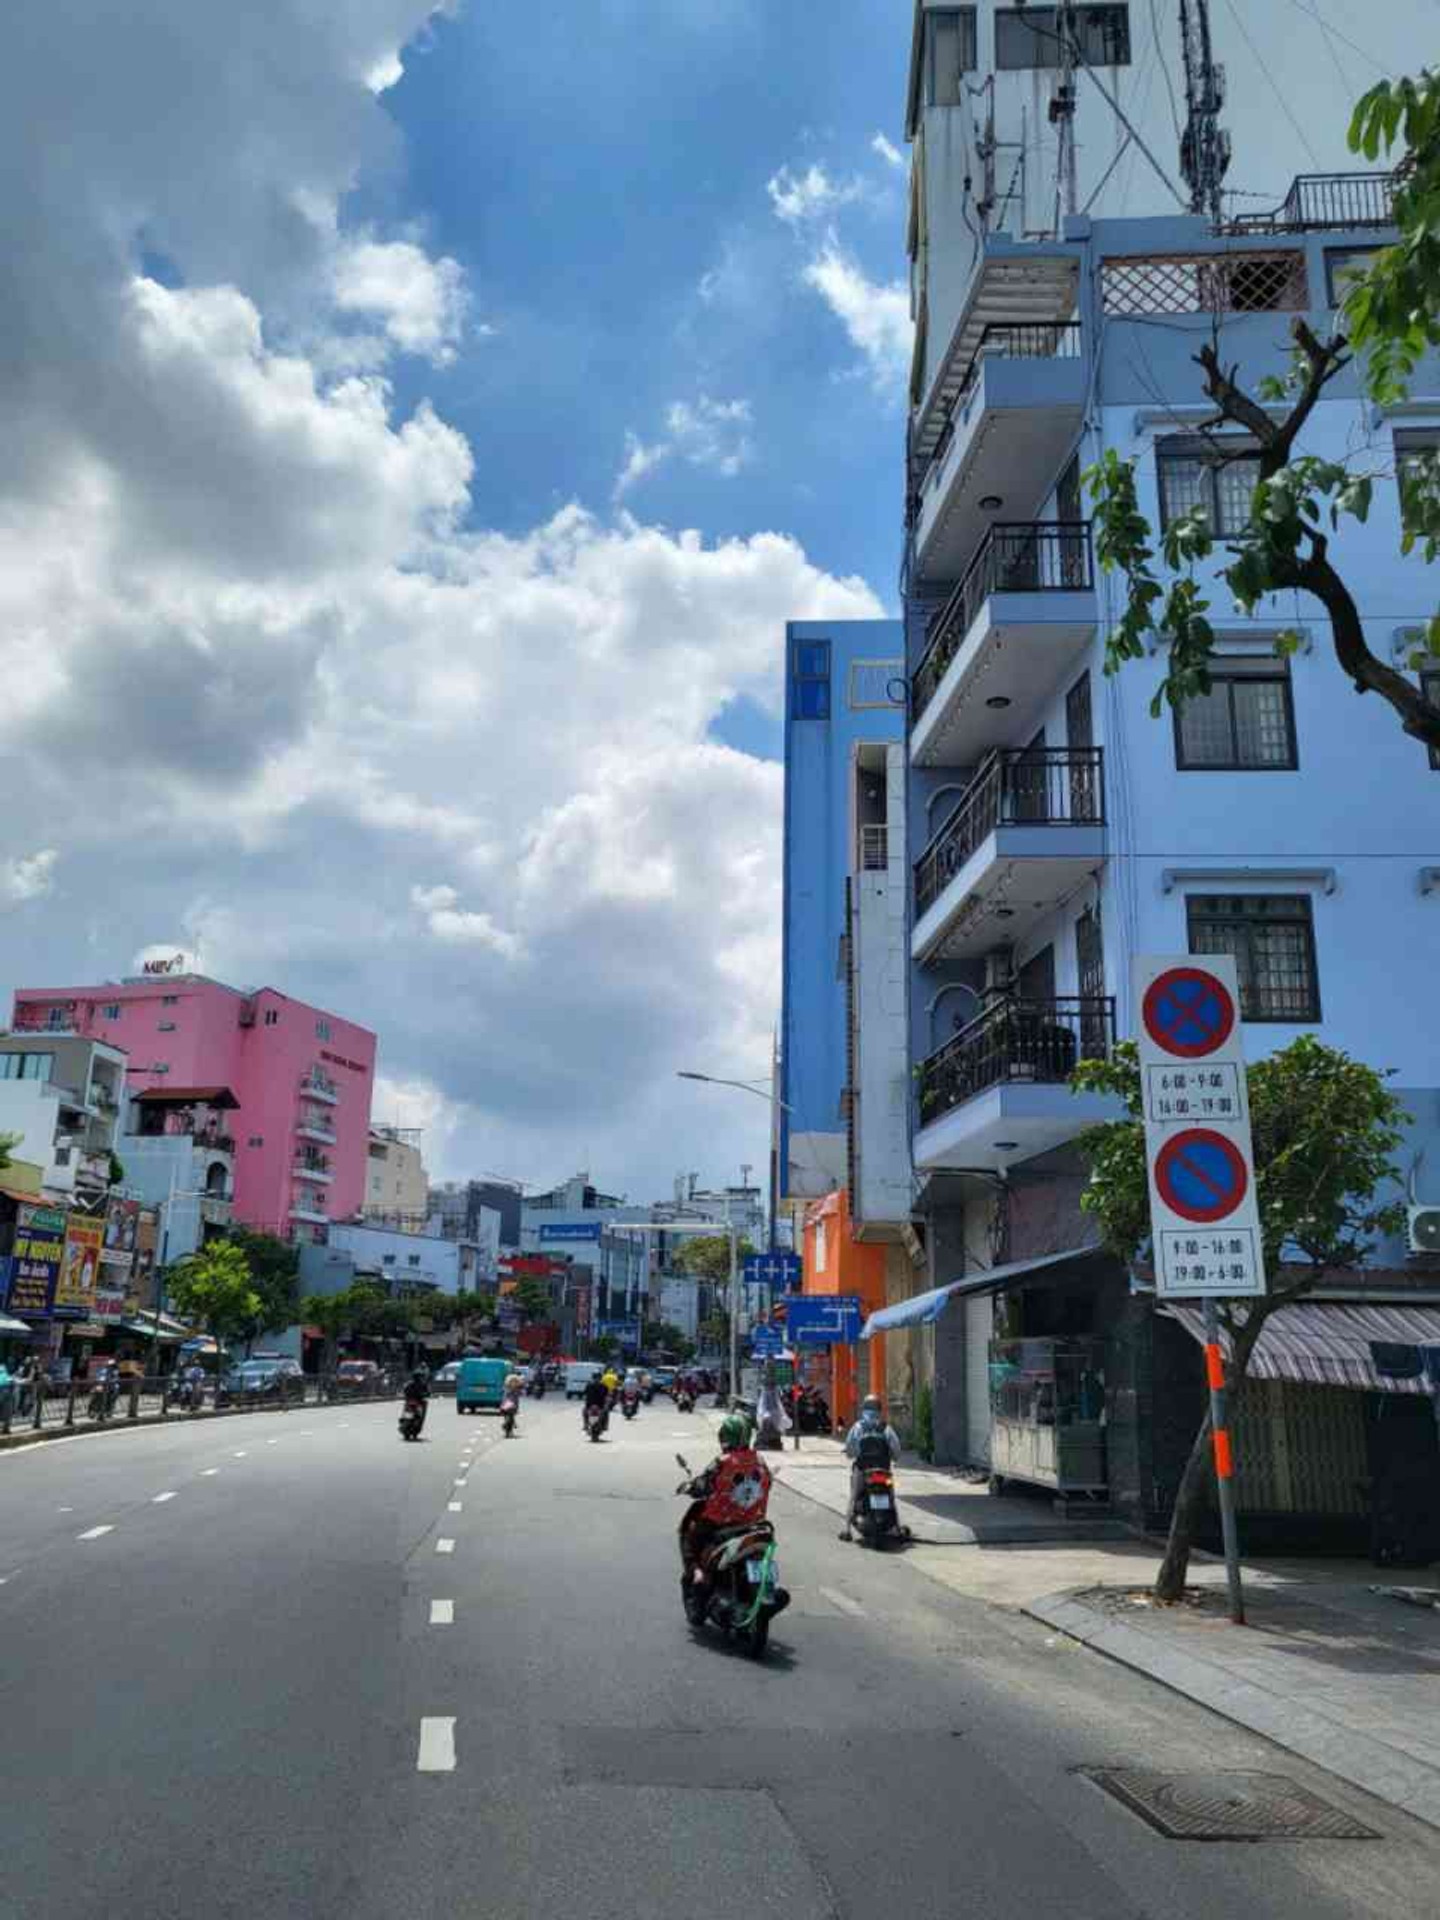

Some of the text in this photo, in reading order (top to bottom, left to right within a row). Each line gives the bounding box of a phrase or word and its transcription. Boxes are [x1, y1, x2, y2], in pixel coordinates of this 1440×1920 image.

[1161, 1073, 1187, 1090] 6:00
[1198, 1072, 1223, 1089] 9:00
[1158, 1098, 1189, 1114] 16:00
[1201, 1097, 1232, 1113] 19:00
[1173, 1239, 1199, 1255] 9:00
[1211, 1238, 1242, 1254] 16:00
[1175, 1264, 1206, 1280] 19:00
[1218, 1263, 1244, 1280] 6:00
